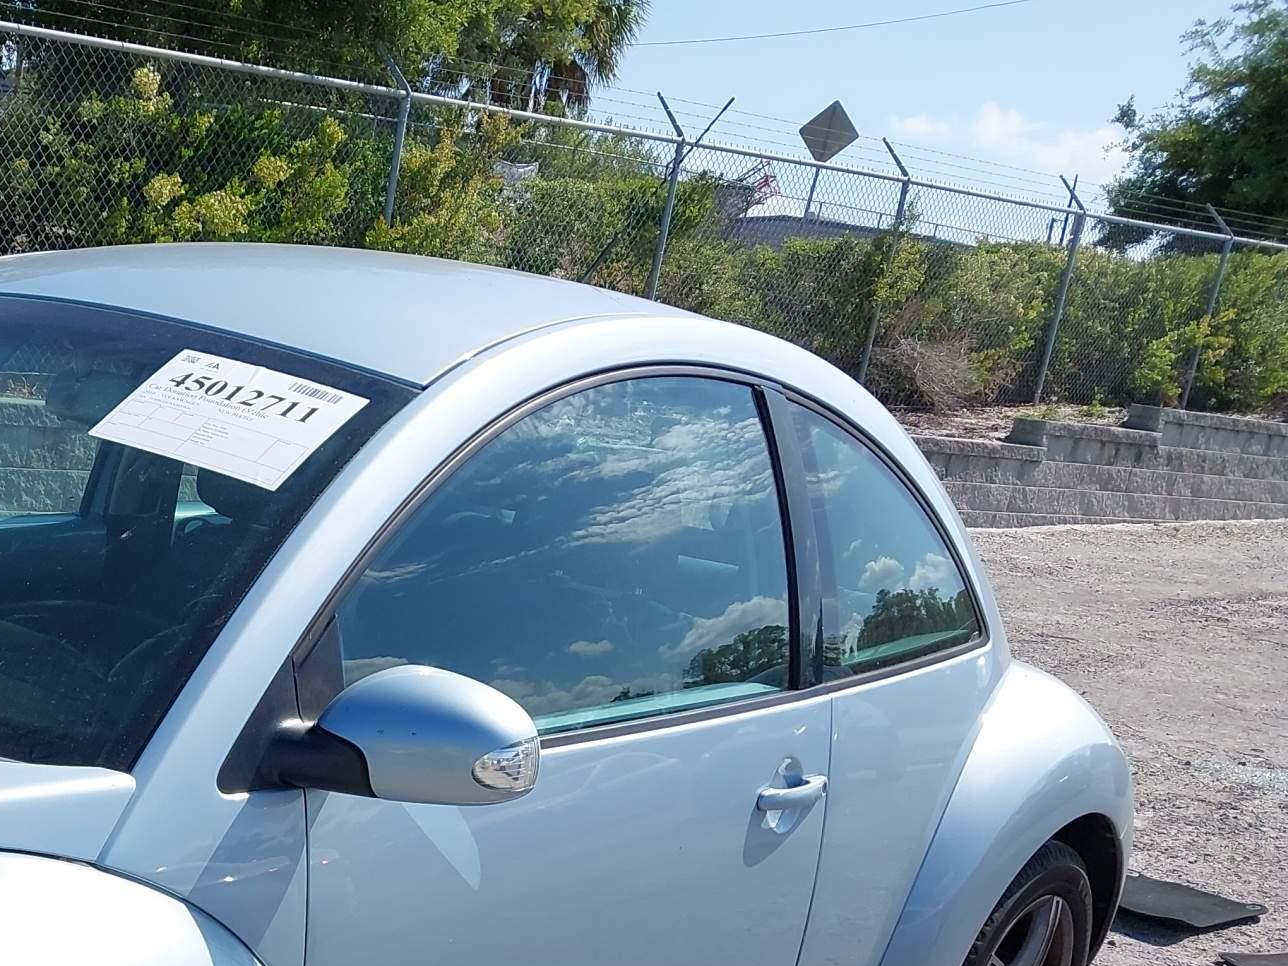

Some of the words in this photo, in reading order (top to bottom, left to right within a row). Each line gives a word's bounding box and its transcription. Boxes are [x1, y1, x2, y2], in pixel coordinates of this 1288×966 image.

[163, 386, 199, 400] Donation
[199, 395, 241, 412] Foundation
[169, 372, 321, 424] 45012711
